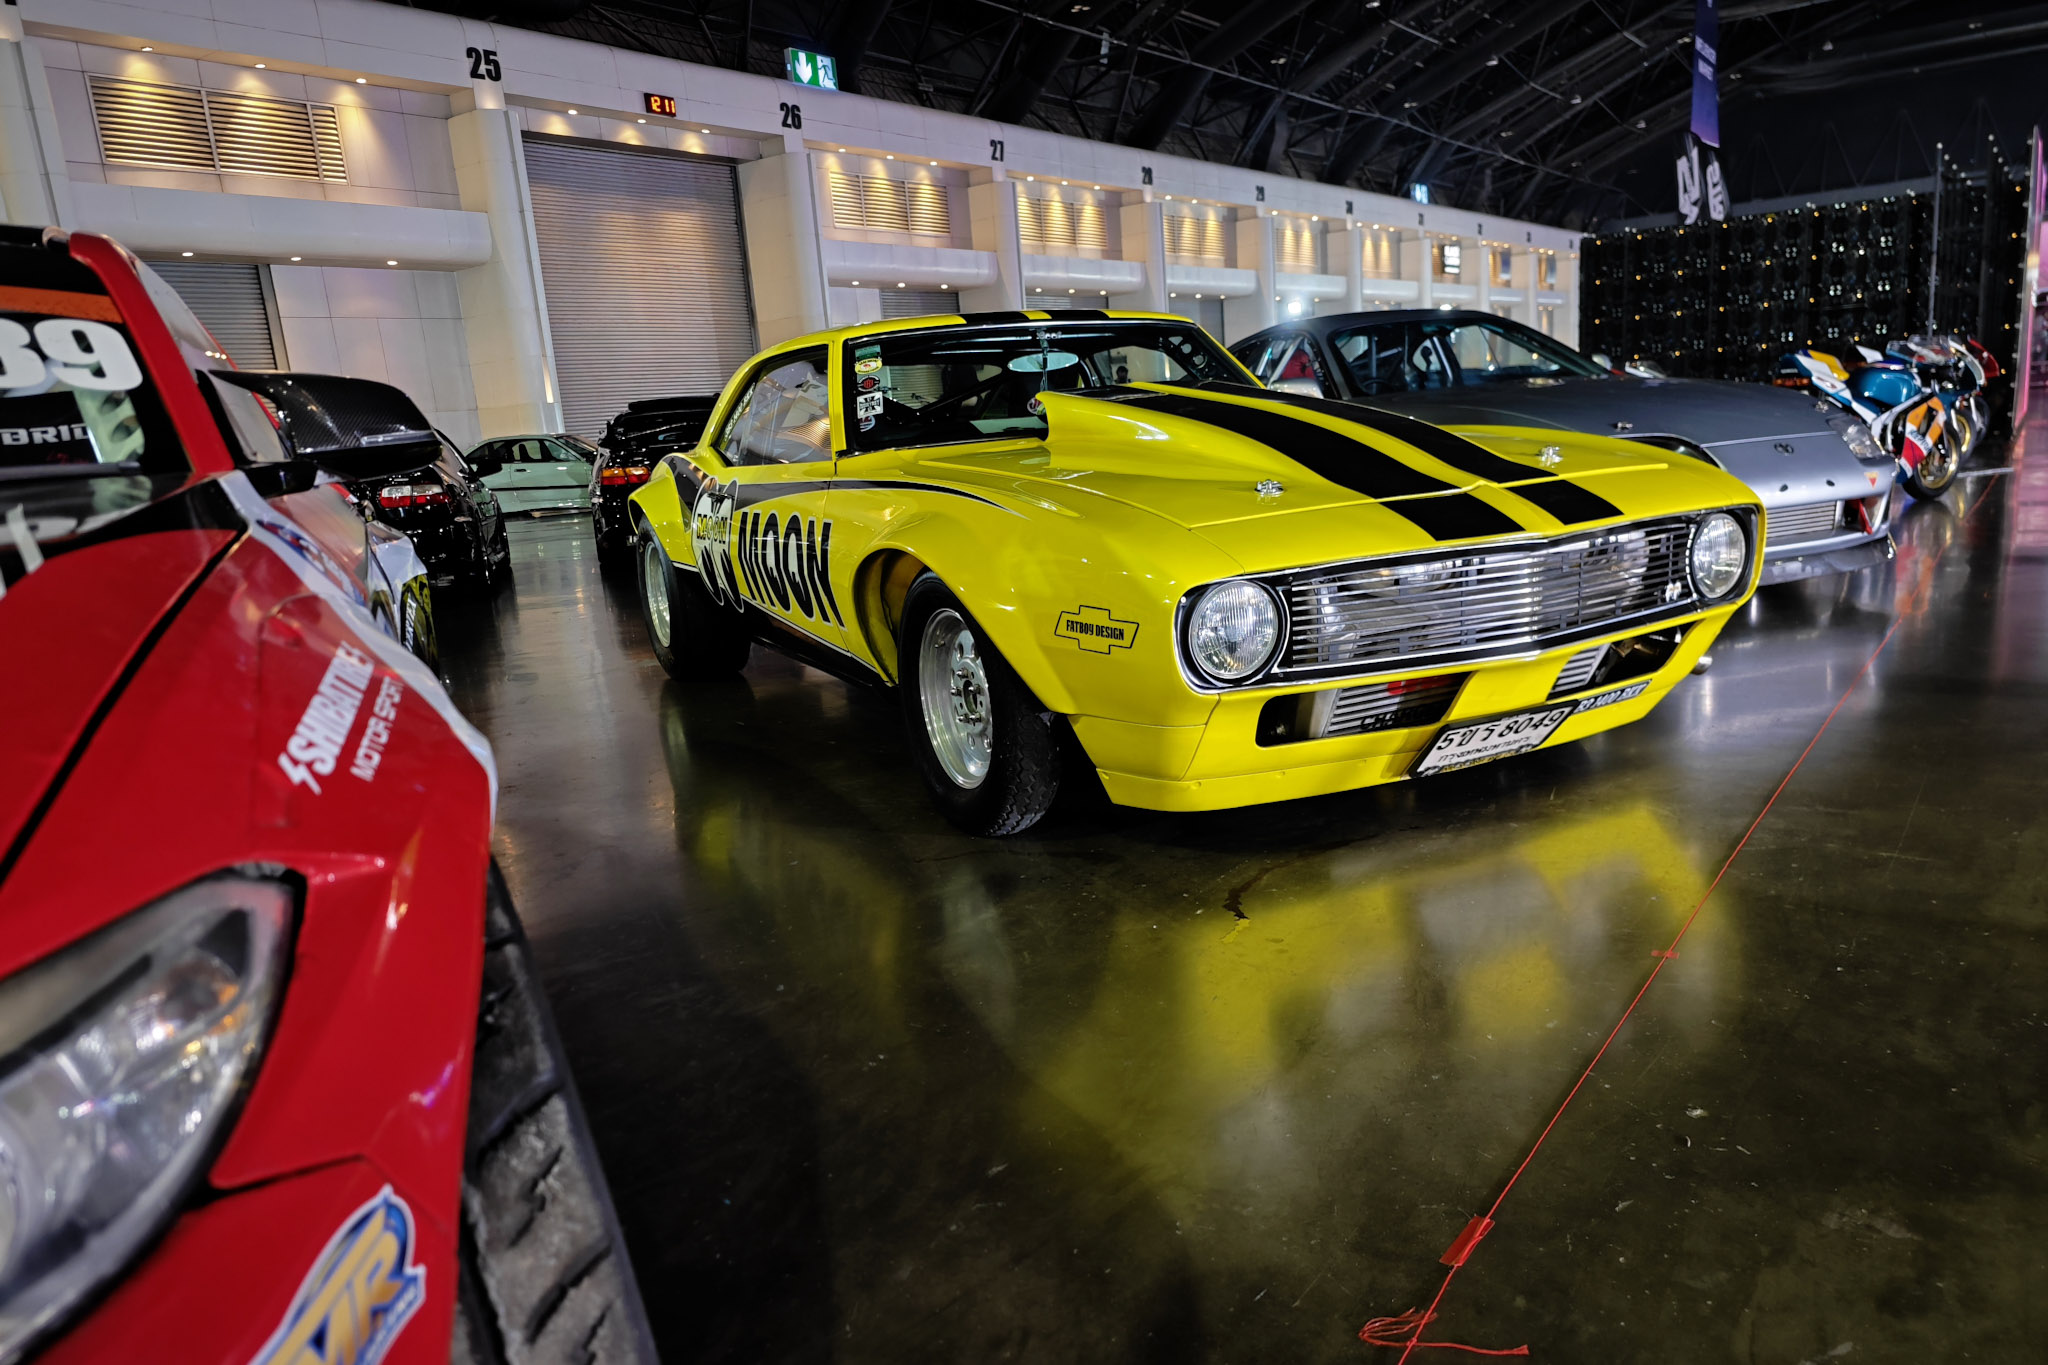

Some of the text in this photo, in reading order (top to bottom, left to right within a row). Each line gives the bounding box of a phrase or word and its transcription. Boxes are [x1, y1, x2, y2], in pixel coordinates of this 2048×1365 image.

[466, 46, 501, 82] 25
[780, 102, 802, 130] 26
[989, 139, 1005, 162] 27
[737, 510, 846, 630] MOON
[1066, 619, 1125, 641] FATBOY DESIGN
[1497, 710, 1566, 738] 8049
[349, 715, 393, 782] MOTOR
